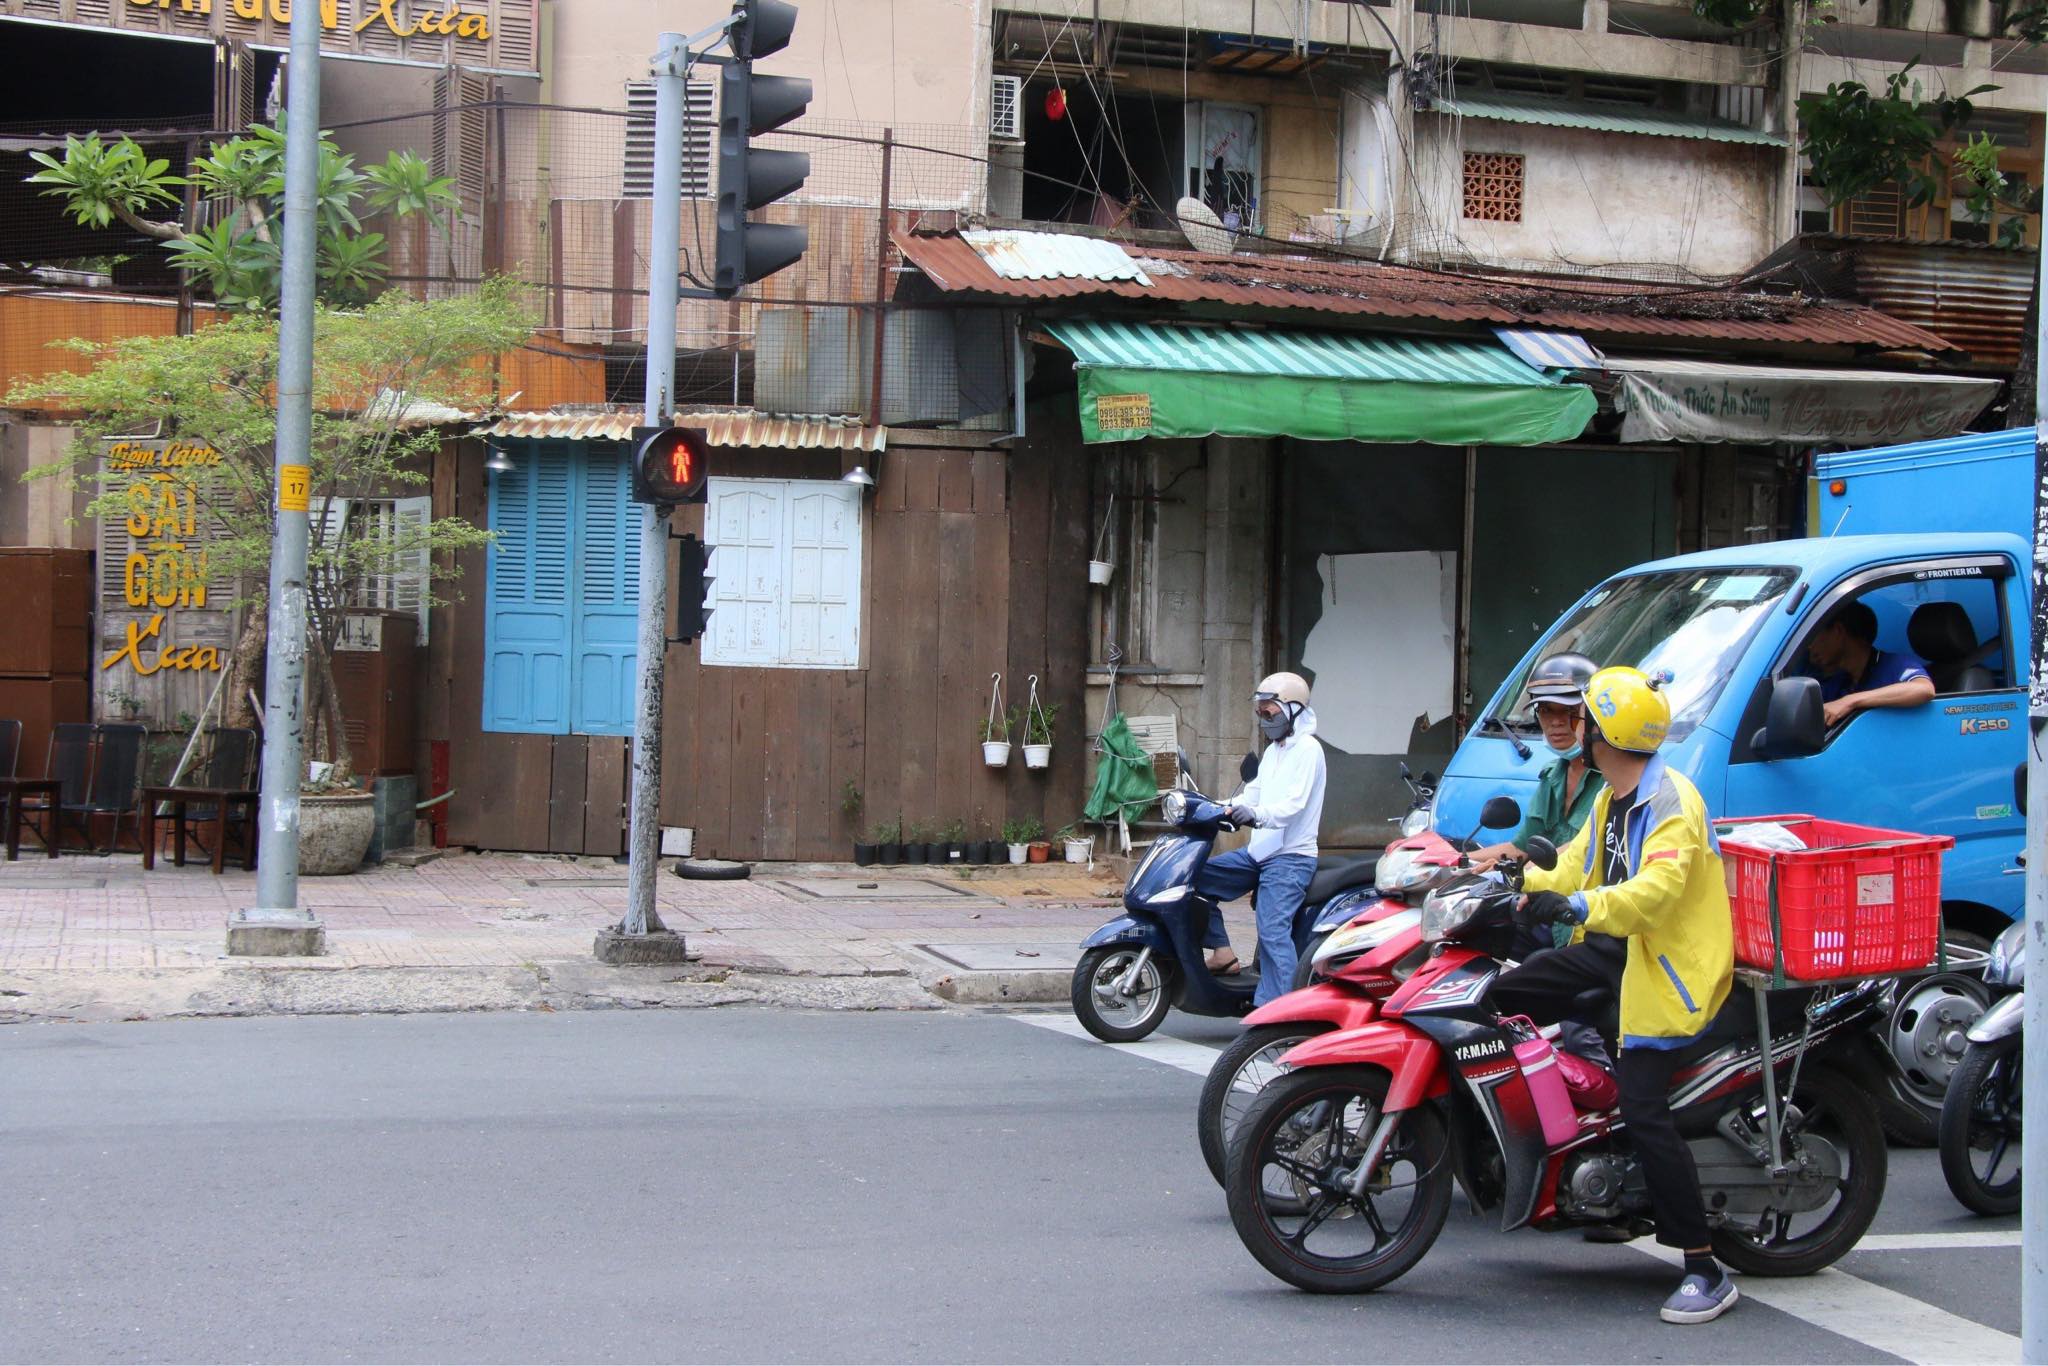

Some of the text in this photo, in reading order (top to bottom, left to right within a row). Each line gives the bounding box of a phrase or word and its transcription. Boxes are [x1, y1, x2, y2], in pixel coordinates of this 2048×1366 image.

[1740, 385, 1771, 422] Sáng
[289, 481, 305, 496] 17
[1927, 568, 1966, 579] FRONTIER
[1966, 566, 1982, 576] KIA
[103, 612, 221, 677] Xưa
[1944, 705, 1964, 715] NEW
[1364, 980, 1395, 989] HONDA
[1454, 1039, 1507, 1062] YAMAHA
